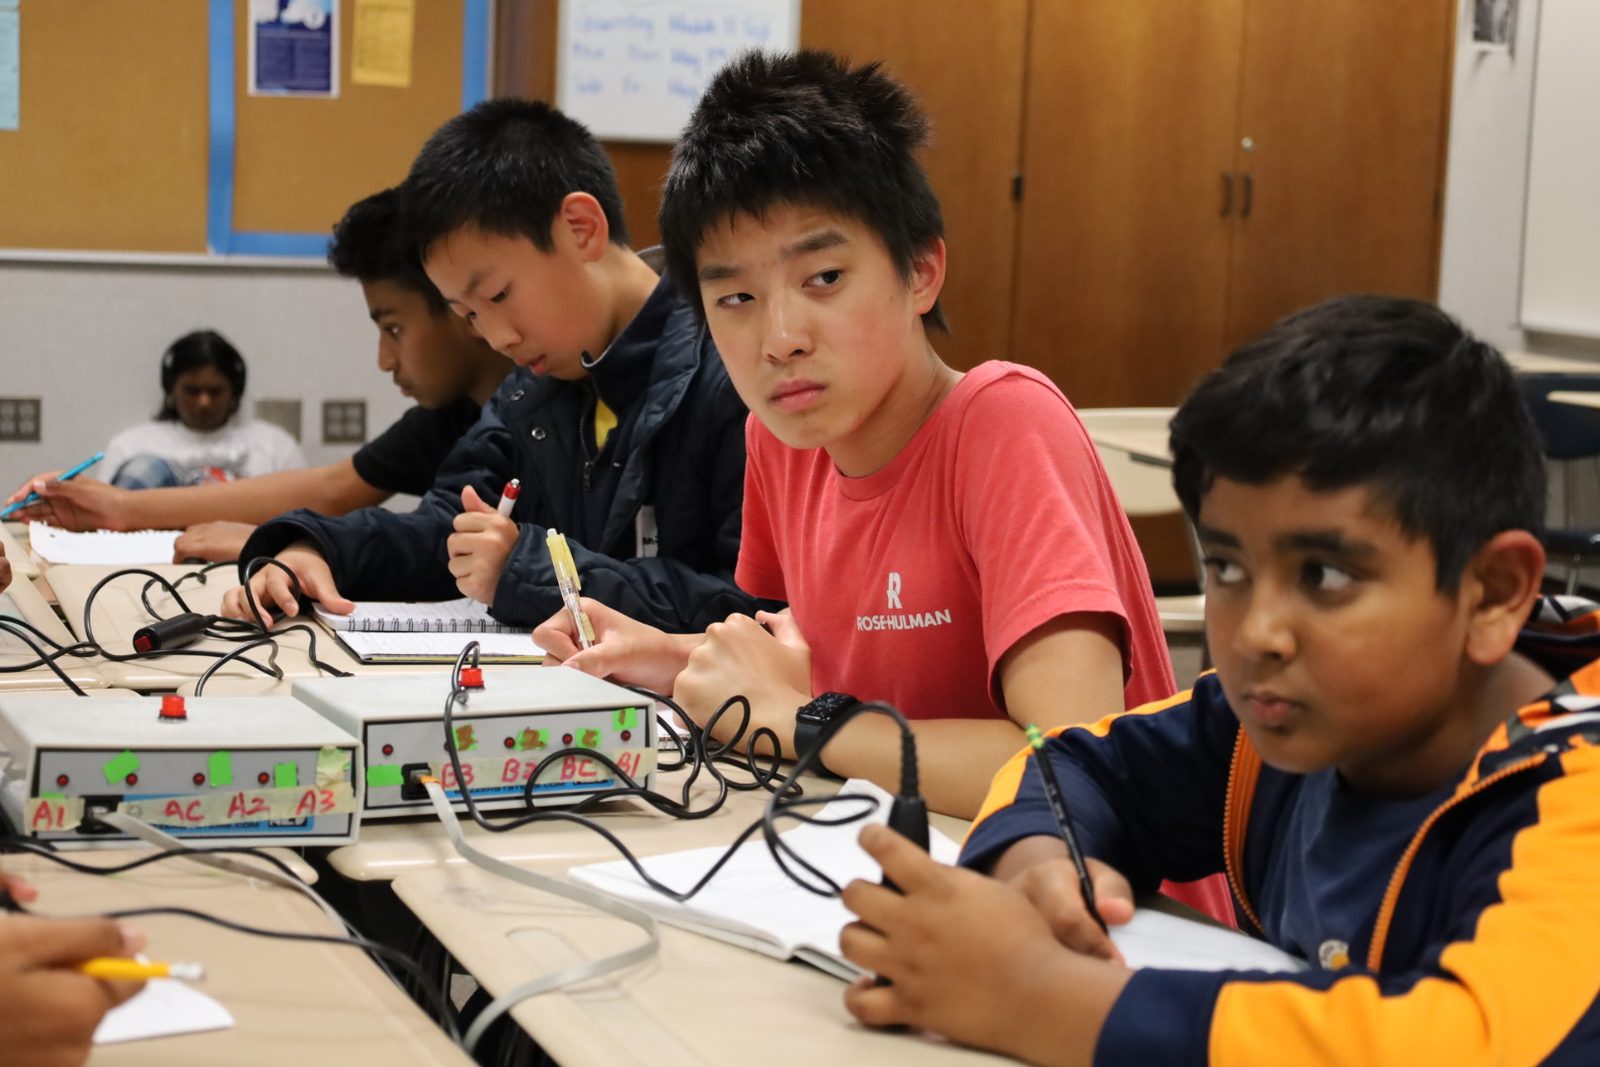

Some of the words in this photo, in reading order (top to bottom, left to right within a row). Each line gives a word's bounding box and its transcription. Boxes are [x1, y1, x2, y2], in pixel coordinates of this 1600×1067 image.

[886, 572, 903, 609] R
[856, 609, 952, 631] ROSE-HULMAN
[441, 762, 475, 789] B3
[560, 754, 597, 781] BC
[617, 751, 641, 780] B1
[32, 801, 65, 830] A1
[163, 800, 205, 822] AC
[227, 792, 271, 819] A2
[295, 789, 337, 816] A3
